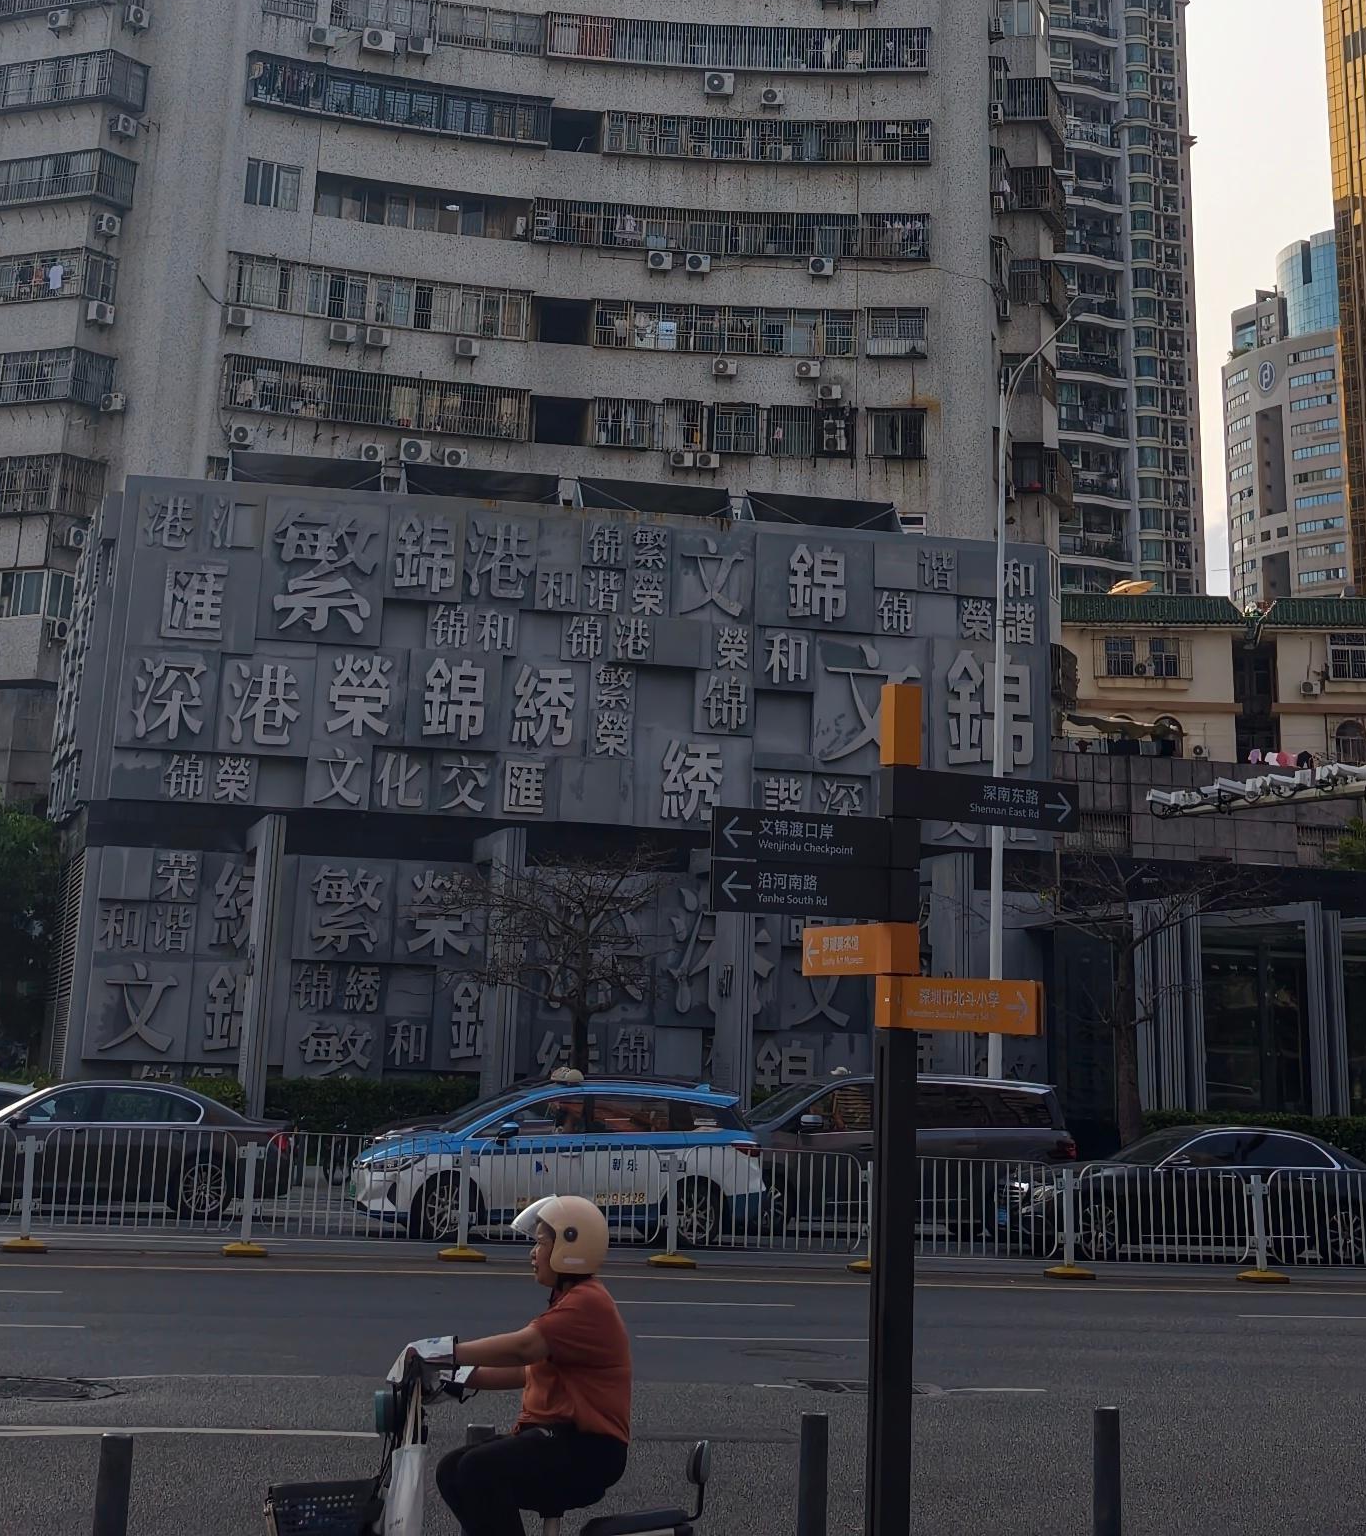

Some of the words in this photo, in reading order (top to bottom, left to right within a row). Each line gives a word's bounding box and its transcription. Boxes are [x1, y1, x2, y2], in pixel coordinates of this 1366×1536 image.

[272, 508, 380, 635] 繁
[679, 536, 746, 618] 文
[787, 543, 847, 624] 錦
[918, 548, 956, 592] 谐
[1002, 557, 1036, 598] 和
[161, 559, 229, 641] 匯
[877, 591, 915, 635] 锦
[716, 626, 749, 671] 榮
[764, 631, 810, 685] 和
[596, 664, 633, 711] 繁
[702, 674, 749, 731] 锦
[817, 642, 923, 763] 文
[946, 648, 1035, 774] 錦
[595, 710, 630, 758] 榮
[313, 746, 547, 815] 文化交匯
[982, 783, 1040, 806] 深南东路
[758, 818, 835, 841] 文锦渡口岸
[969, 802, 1007, 816] Shennan
[1008, 806, 1027, 818] East
[1028, 808, 1040, 819] Rd
[758, 839, 802, 853] Wenjindu
[803, 843, 854, 857] Checkpoint
[155, 852, 198, 900] 荣
[757, 871, 819, 893] 沿河南路
[757, 893, 785, 905] Yanhe
[786, 894, 814, 906] South
[816, 896, 828, 906] Rd
[97, 962, 180, 1053] 文
[386, 1018, 429, 1067] 和
[611, 1026, 651, 1075] 锦
